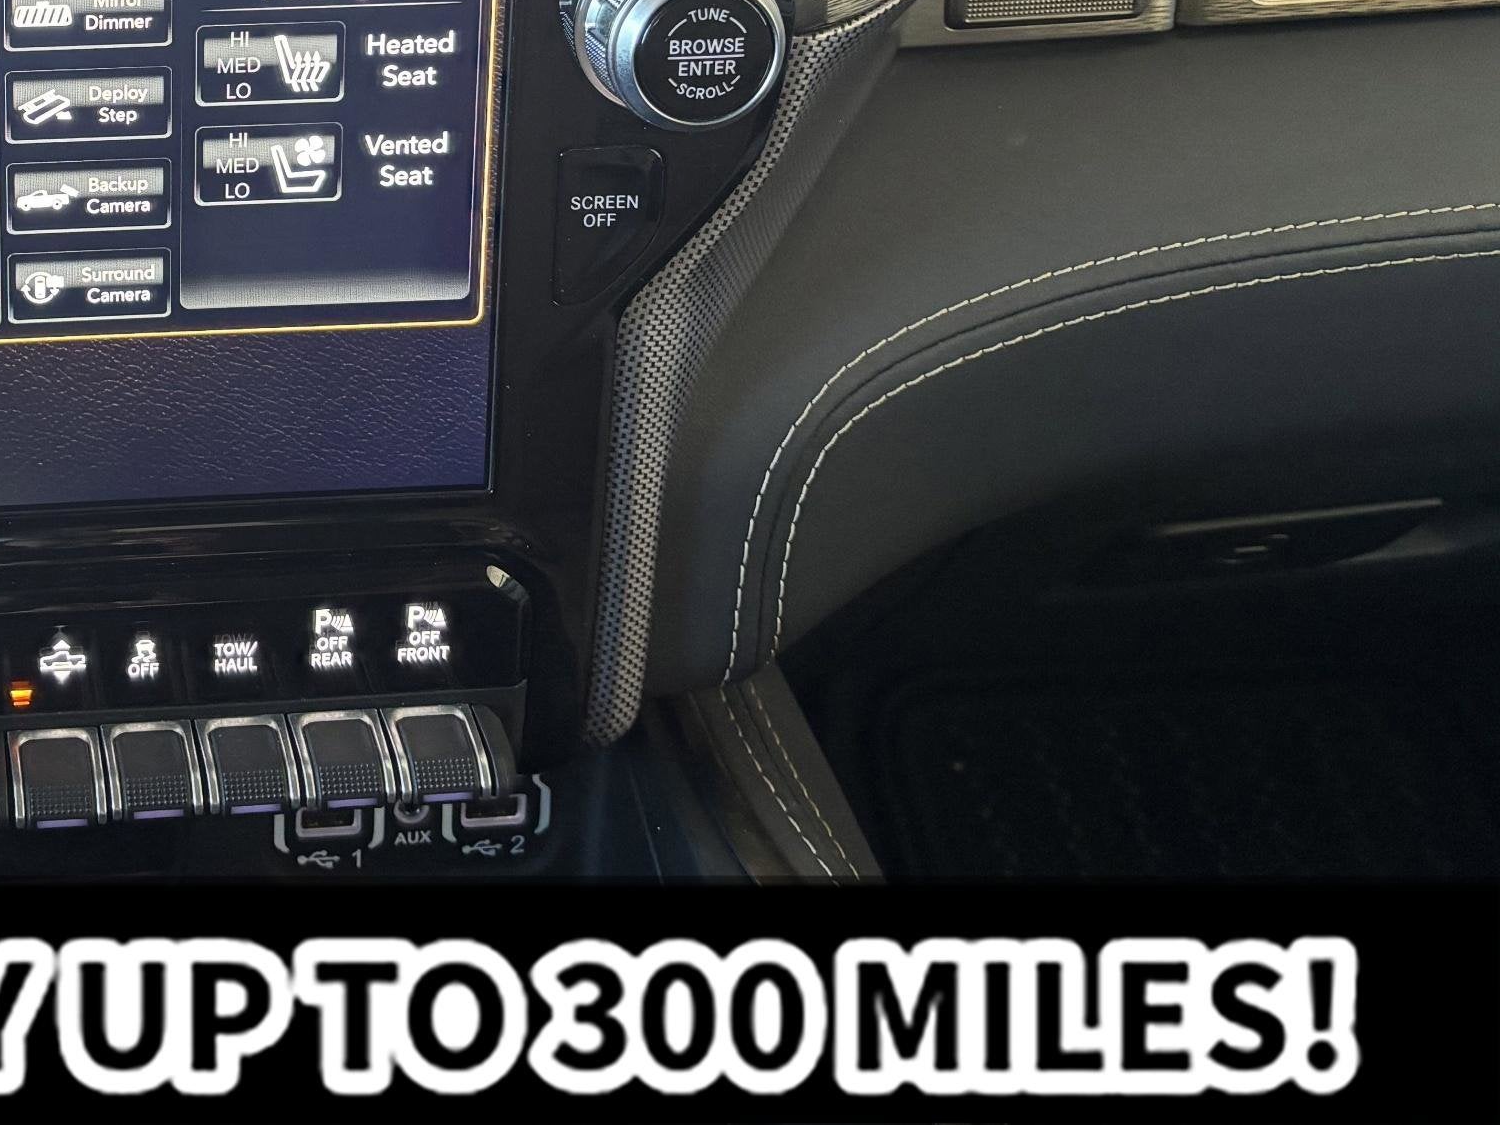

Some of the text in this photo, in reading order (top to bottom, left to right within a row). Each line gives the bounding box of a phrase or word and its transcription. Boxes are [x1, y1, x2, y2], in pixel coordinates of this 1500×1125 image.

[85, 14, 153, 31] Dimmer
[688, 8, 731, 24] TUNE
[230, 31, 249, 47] HI
[367, 30, 455, 56] Heated
[669, 37, 745, 55] BROWSE
[217, 57, 260, 74] MED
[678, 59, 736, 76] ENTER
[382, 65, 437, 88] Seat
[89, 85, 148, 105] Deploy
[225, 83, 251, 100] LO
[676, 81, 734, 100] SCROLL
[98, 106, 137, 125] Step
[229, 133, 248, 148] HI
[365, 132, 449, 156] Vented
[216, 157, 259, 174] MED
[379, 165, 433, 188] Seat
[88, 177, 149, 196] Backup
[224, 183, 250, 200] LO
[86, 197, 151, 214] Camera
[571, 194, 639, 210] SCREEN
[583, 213, 616, 228] OFF
[81, 265, 155, 284] Surround
[86, 286, 151, 304] Camera
[317, 635, 349, 651] OFF
[409, 630, 440, 647] OFF
[214, 640, 258, 659] TOW/
[311, 649, 352, 667] REAR
[397, 644, 450, 663] FRONT
[128, 660, 159, 678] OFF
[214, 657, 258, 674] HAUL
[394, 830, 432, 846] AUX
[510, 835, 525, 854] 2
[351, 849, 362, 868] 1
